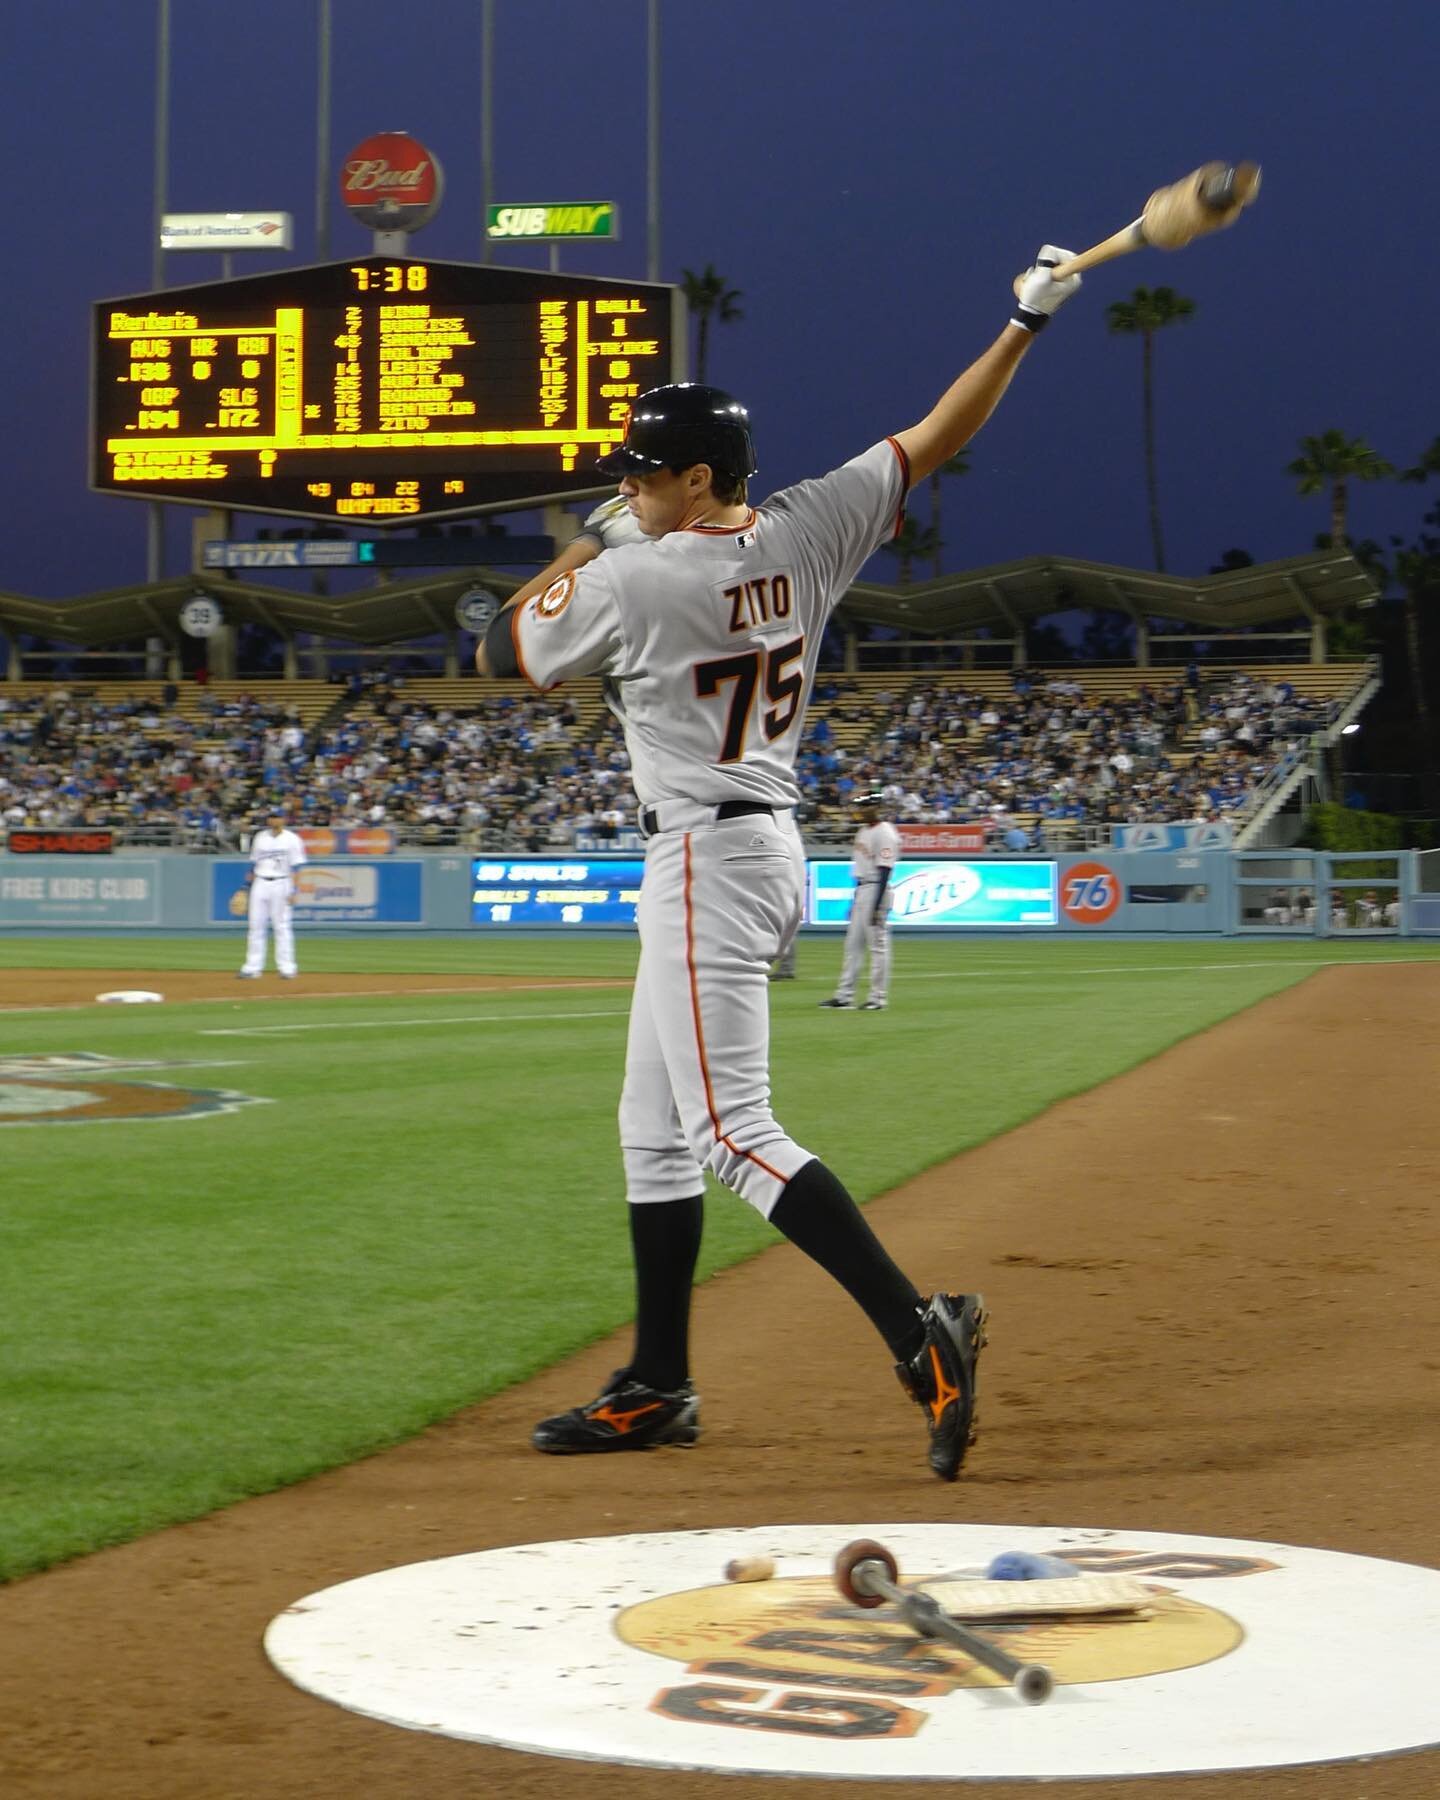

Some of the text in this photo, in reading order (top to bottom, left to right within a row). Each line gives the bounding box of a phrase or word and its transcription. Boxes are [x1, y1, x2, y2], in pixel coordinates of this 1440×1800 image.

[345, 159, 429, 191] Bud
[488, 205, 613, 236] SUBWAY
[351, 266, 427, 291] 7:38
[219, 388, 258, 406] SLG
[114, 452, 212, 466] GIANTS
[336, 498, 420, 514] UMPIRES
[723, 574, 791, 633] ZITO
[693, 636, 804, 764] 75
[12, 834, 111, 851] SHARP
[2, 877, 147, 899] FREE KIDS CLUB
[902, 877, 967, 916] Lite
[1064, 874, 1114, 910] 76
